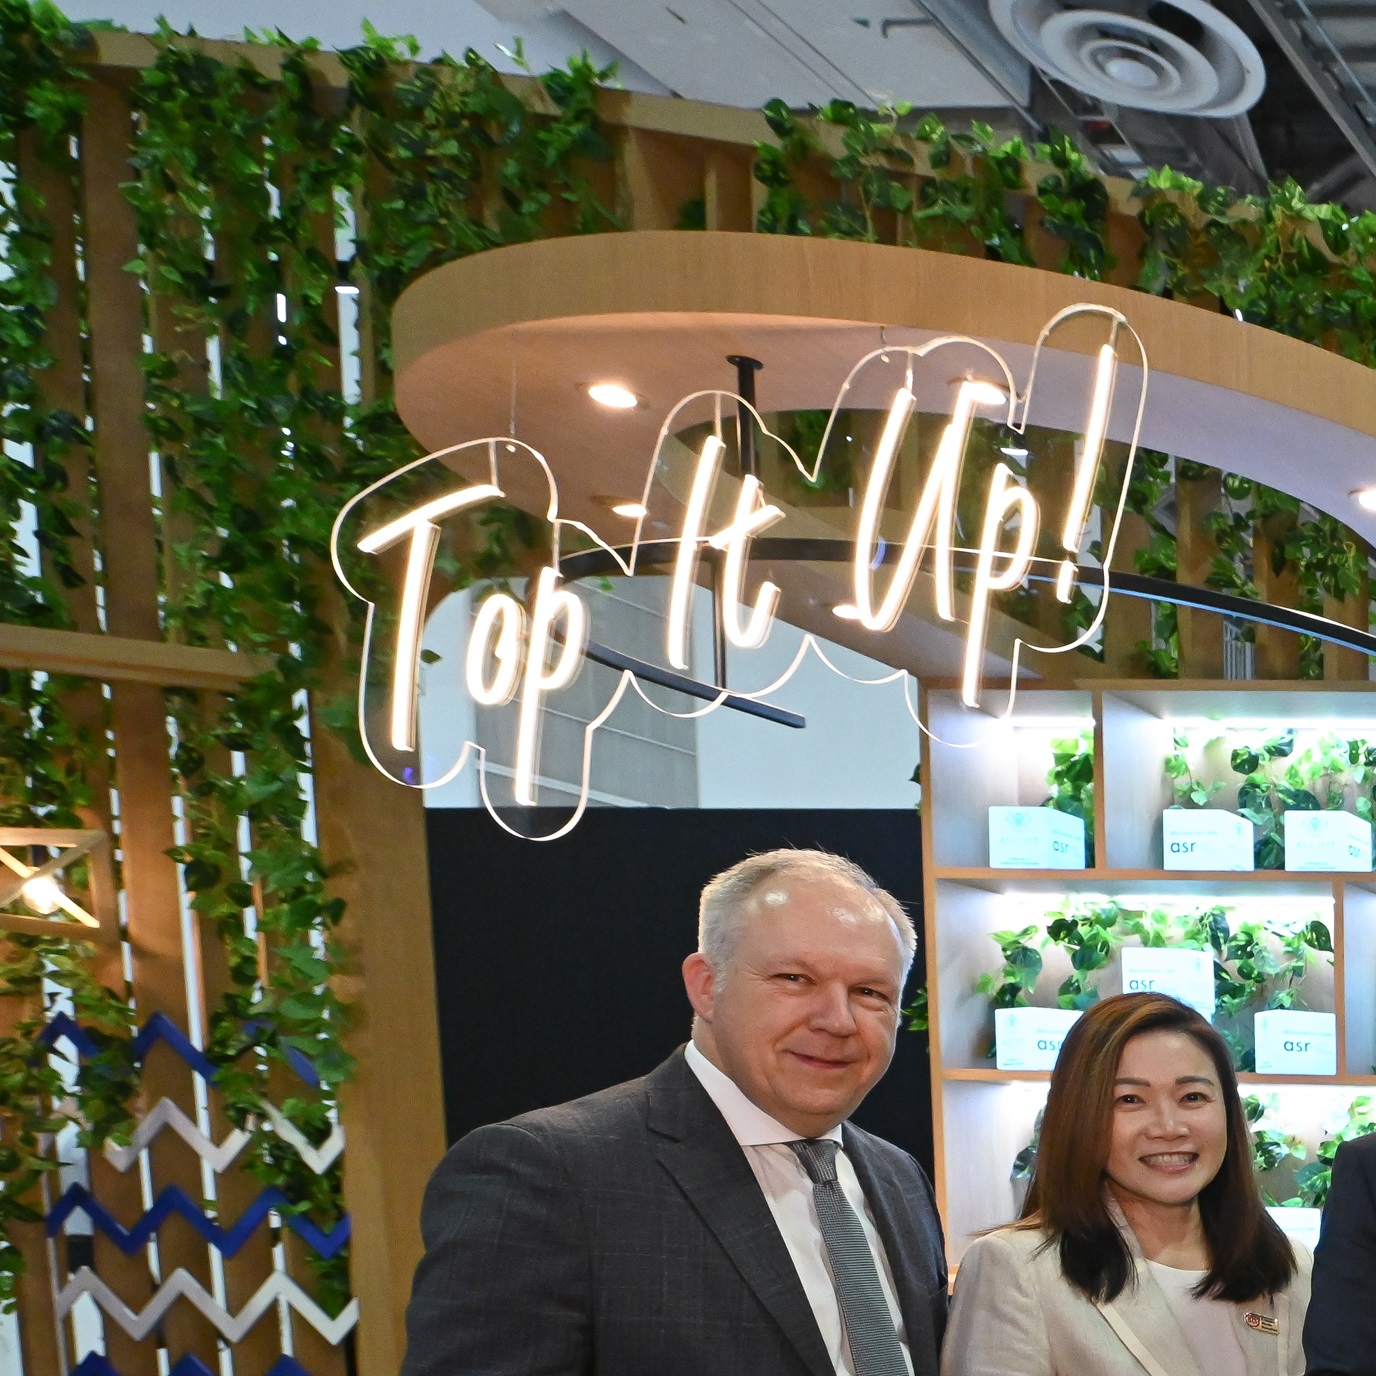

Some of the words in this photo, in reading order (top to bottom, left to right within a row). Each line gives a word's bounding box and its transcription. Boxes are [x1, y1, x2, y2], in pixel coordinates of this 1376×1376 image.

[357, 484, 588, 806] Top
[668, 435, 785, 670] It
[856, 344, 1117, 708] Up!
[1170, 841, 1197, 853] asr
[1129, 977, 1156, 991] asr
[1283, 1039, 1312, 1053] asr
